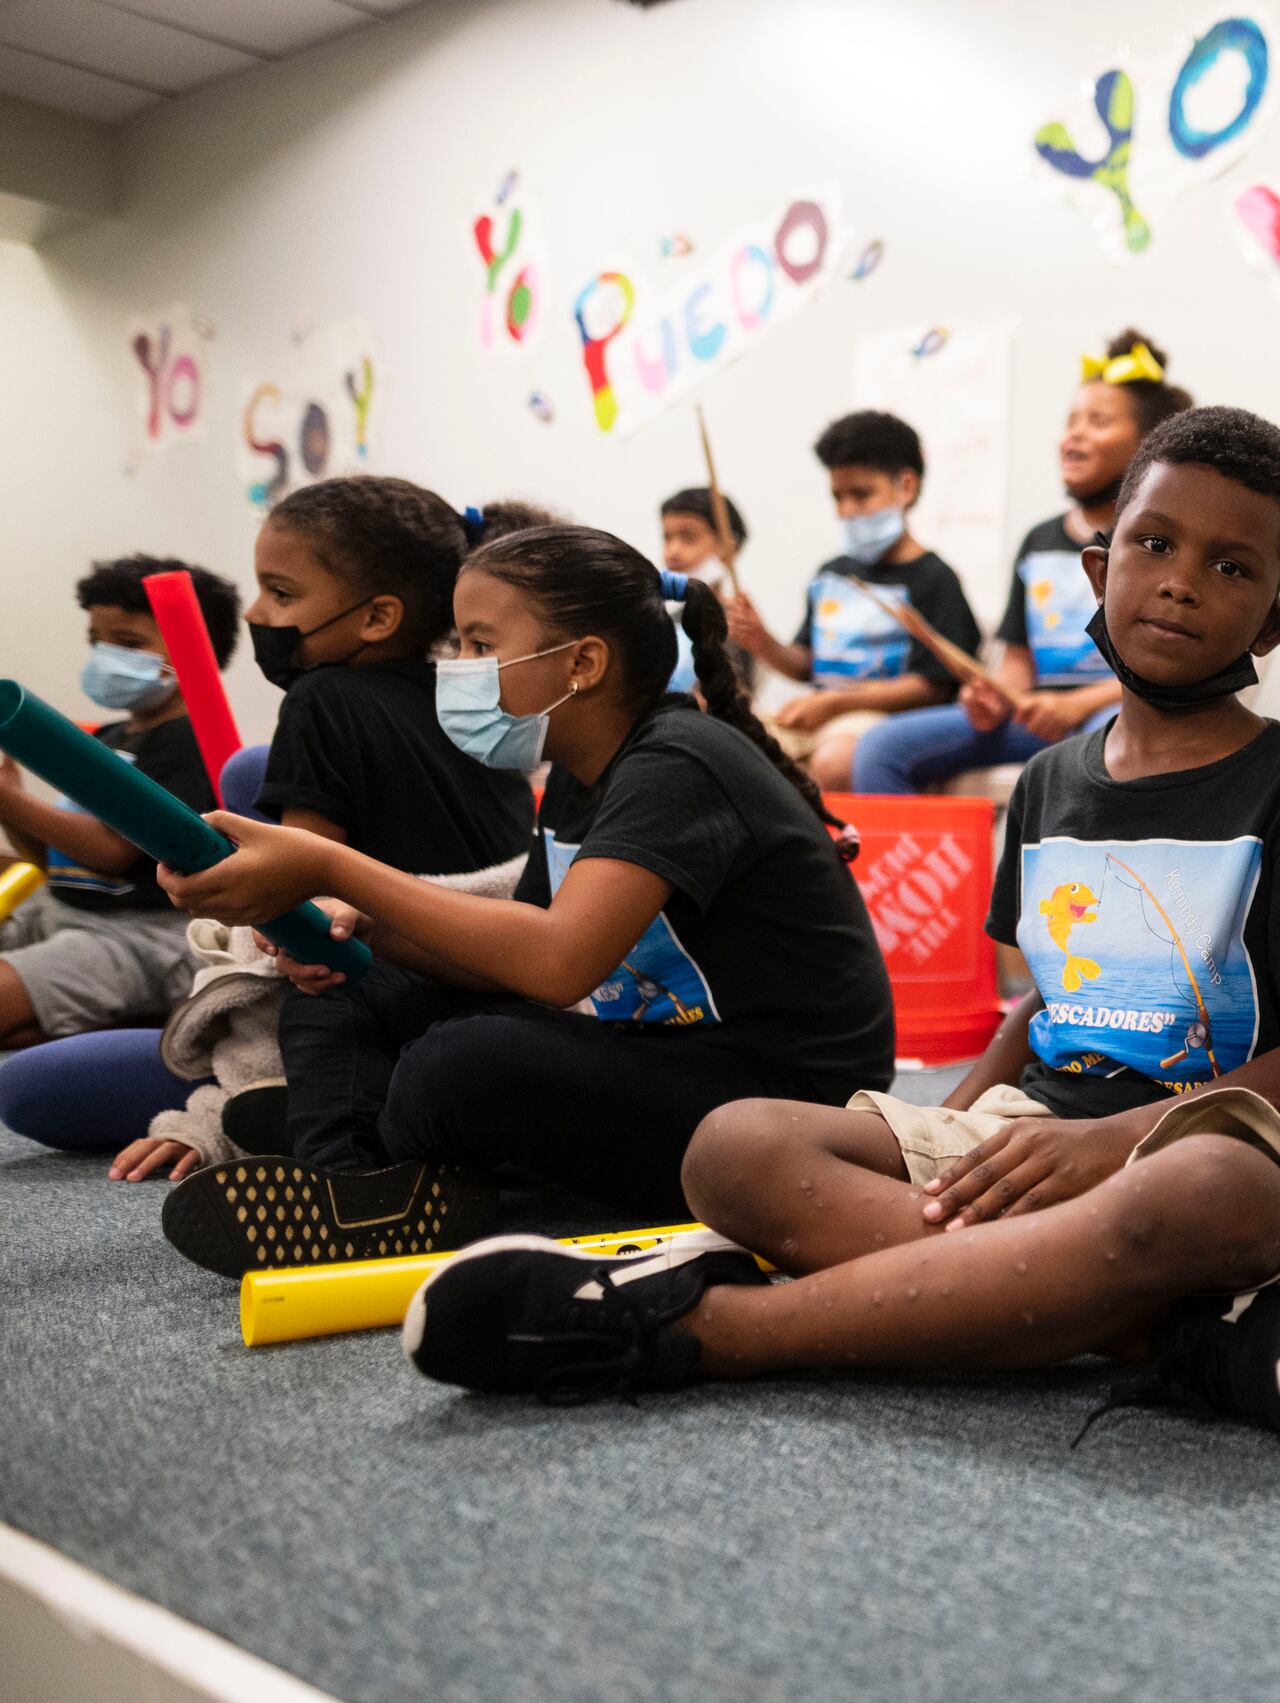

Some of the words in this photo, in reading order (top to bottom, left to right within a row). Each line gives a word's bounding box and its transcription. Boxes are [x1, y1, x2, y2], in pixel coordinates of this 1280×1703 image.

[241, 355, 374, 507] SOY
[869, 832, 974, 953] HOM
[1164, 868, 1201, 935] Kennedy
[1195, 932, 1222, 986] Camp
[1047, 1002, 1177, 1034] ESCADORES”
